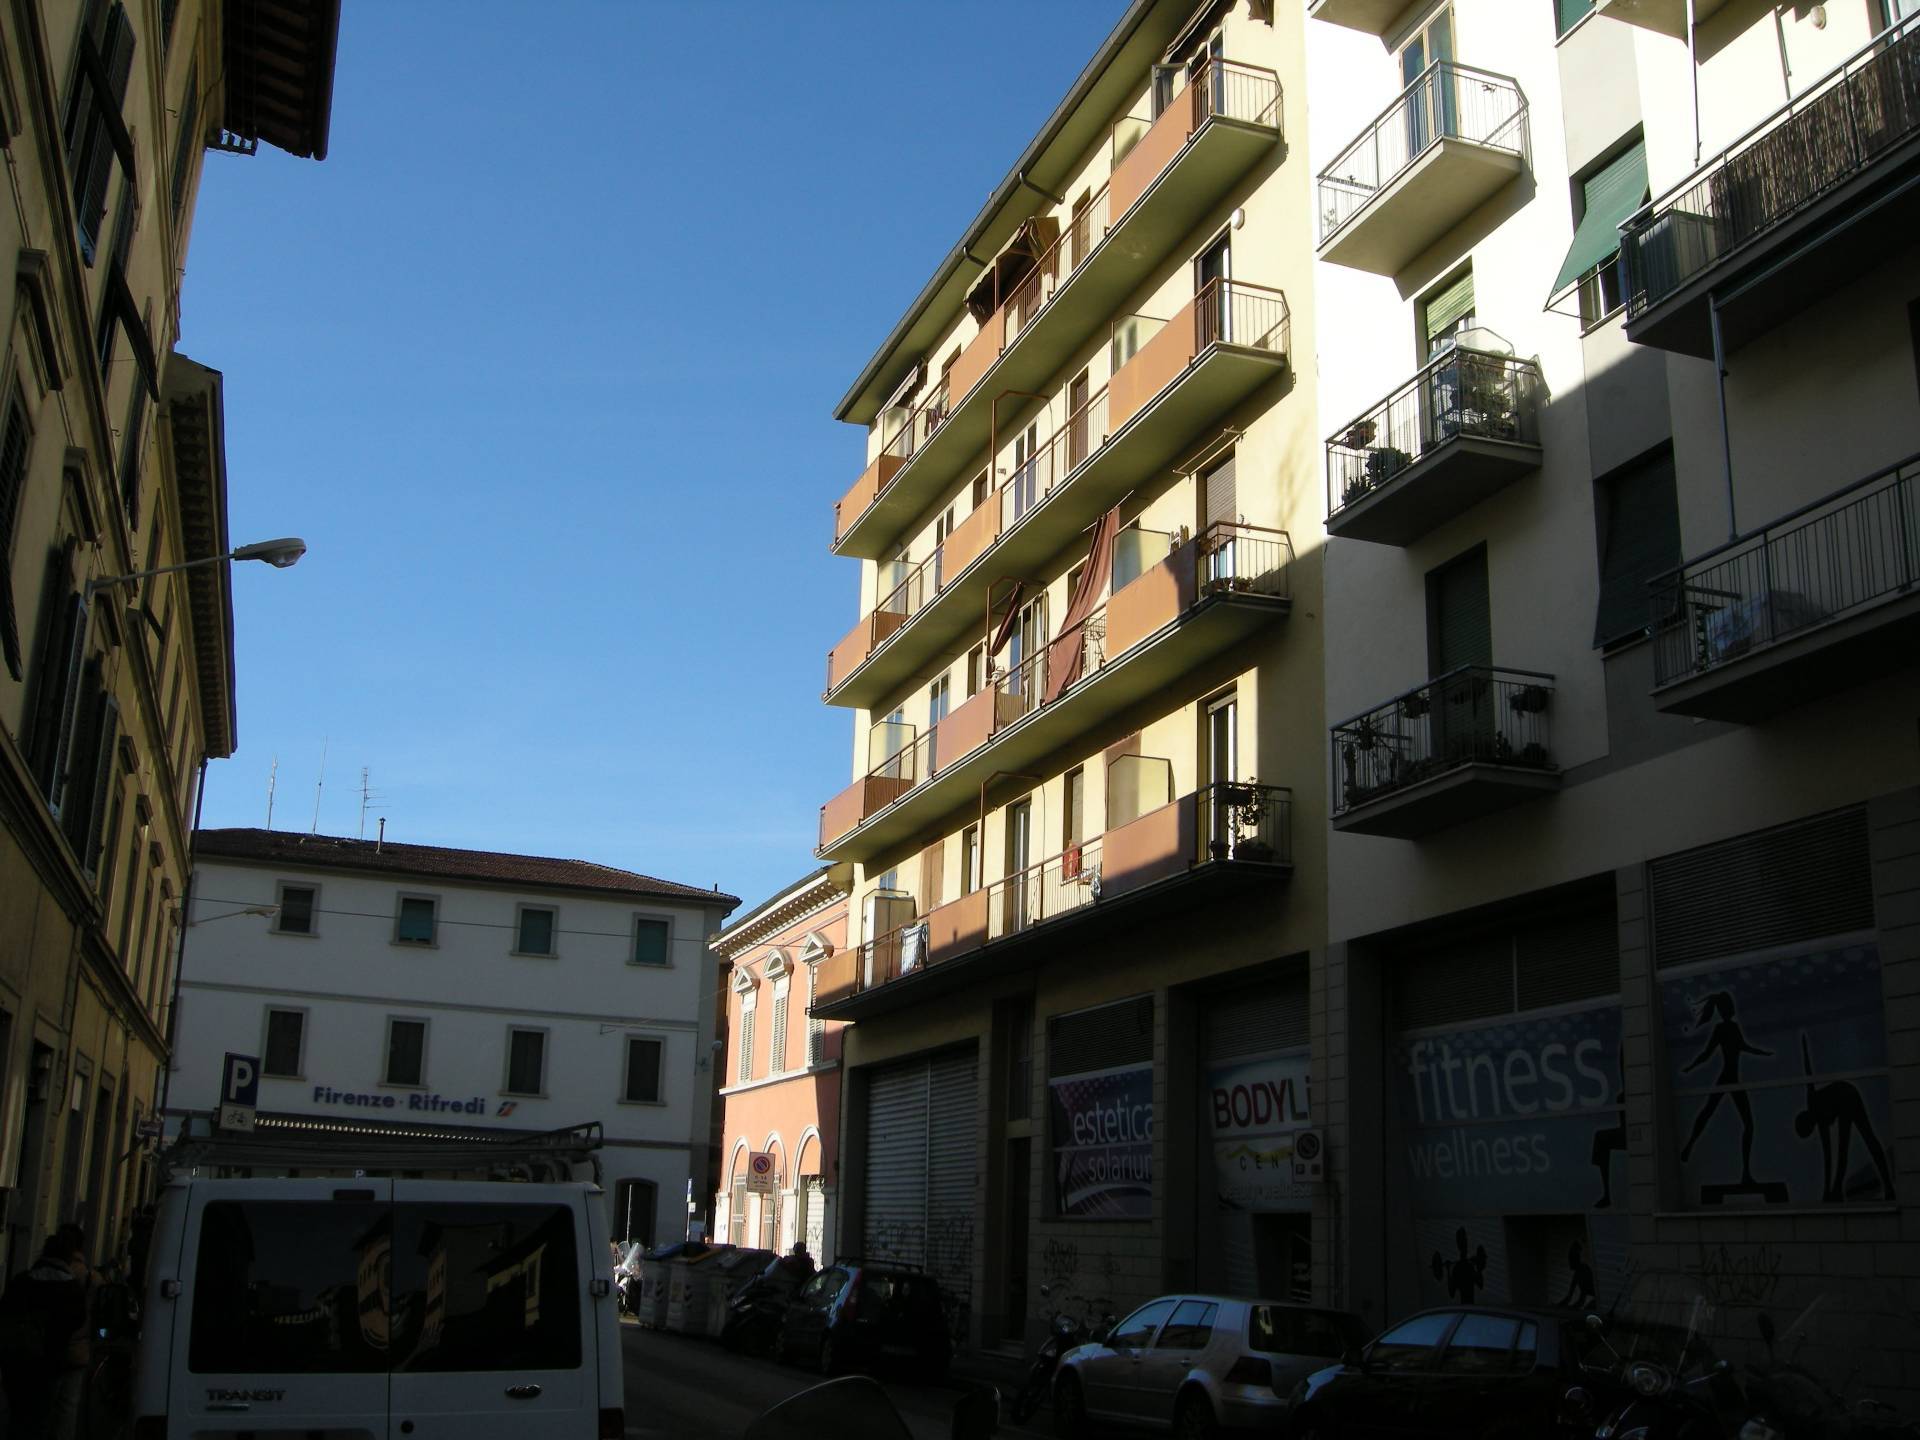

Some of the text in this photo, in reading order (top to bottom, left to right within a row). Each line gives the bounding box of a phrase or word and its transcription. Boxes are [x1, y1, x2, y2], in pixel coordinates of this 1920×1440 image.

[229, 1059, 254, 1101] P
[313, 1086, 486, 1116] Firenze Rifredi
[1408, 1039, 1609, 1122] fitness
[1074, 1094, 1152, 1145] estetica
[1408, 1129, 1552, 1177] wellness
[206, 1388, 287, 1402] TRANSIT
